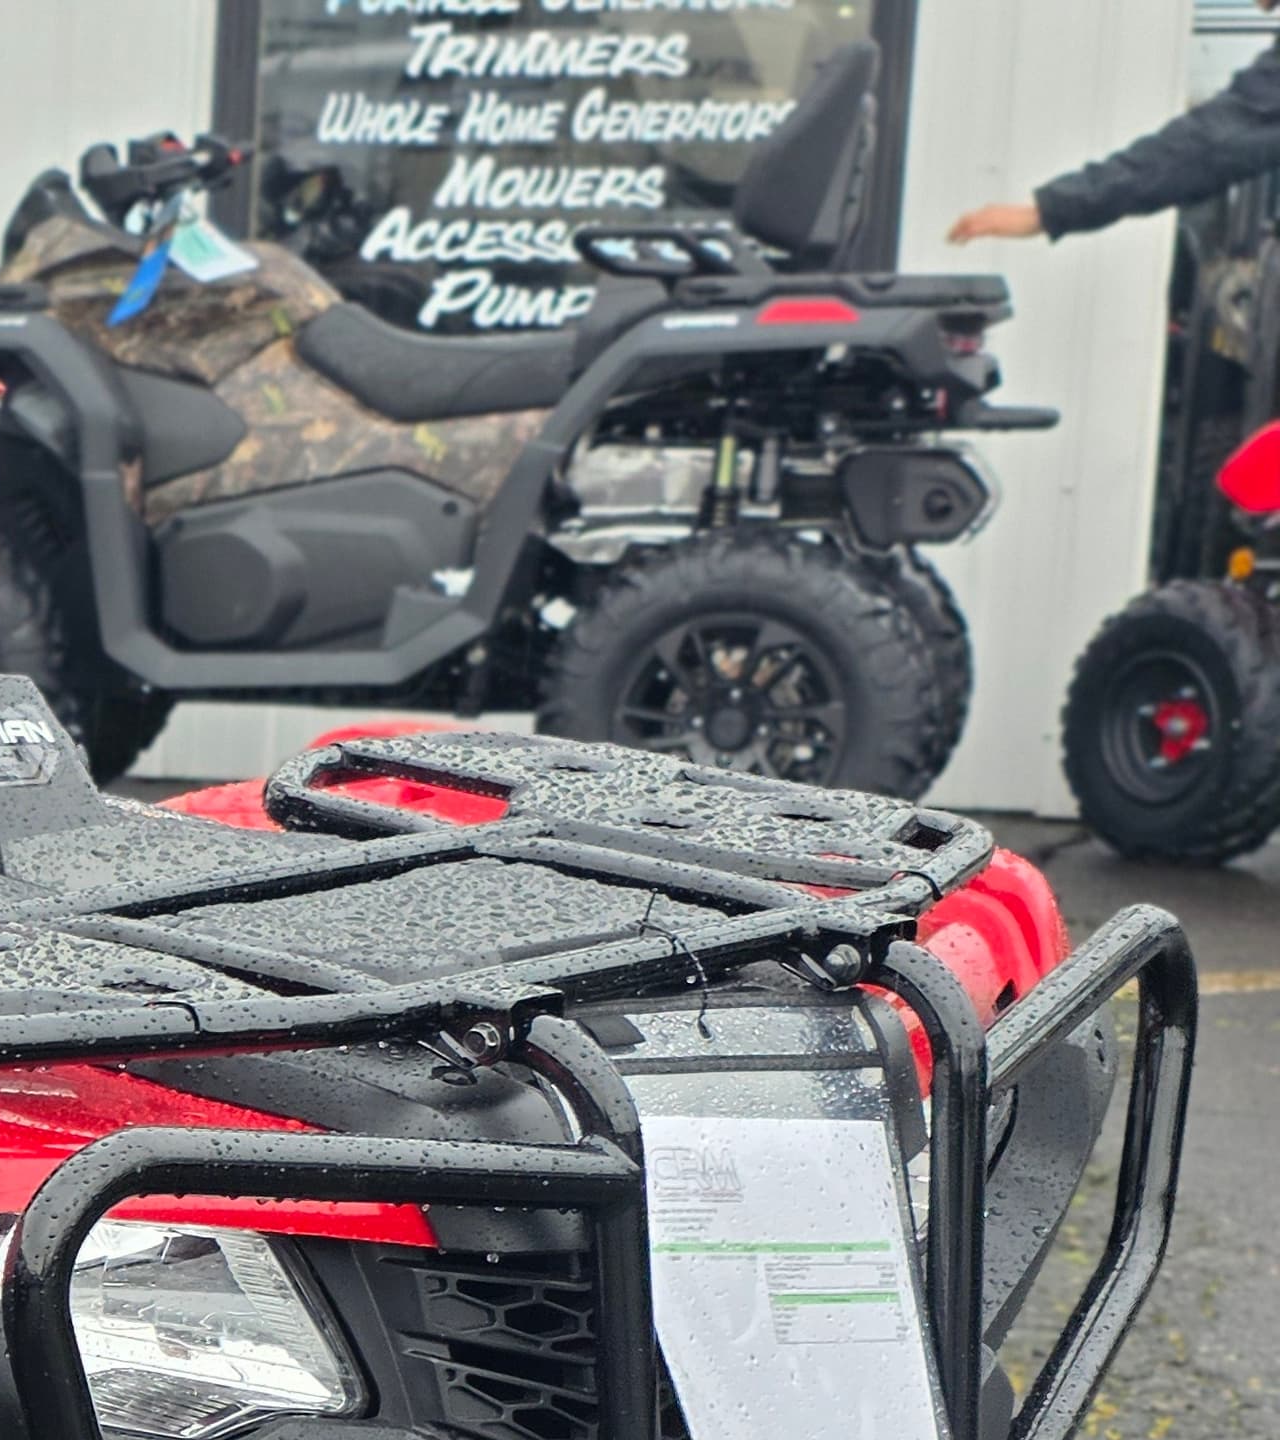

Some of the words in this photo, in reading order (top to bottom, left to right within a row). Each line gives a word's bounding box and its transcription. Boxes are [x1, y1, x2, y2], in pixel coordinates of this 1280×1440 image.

[404, 23, 691, 79] TRIMMERS
[317, 93, 450, 142] WHOLE
[455, 92, 566, 142] HOME
[433, 156, 667, 209] MOWERS
